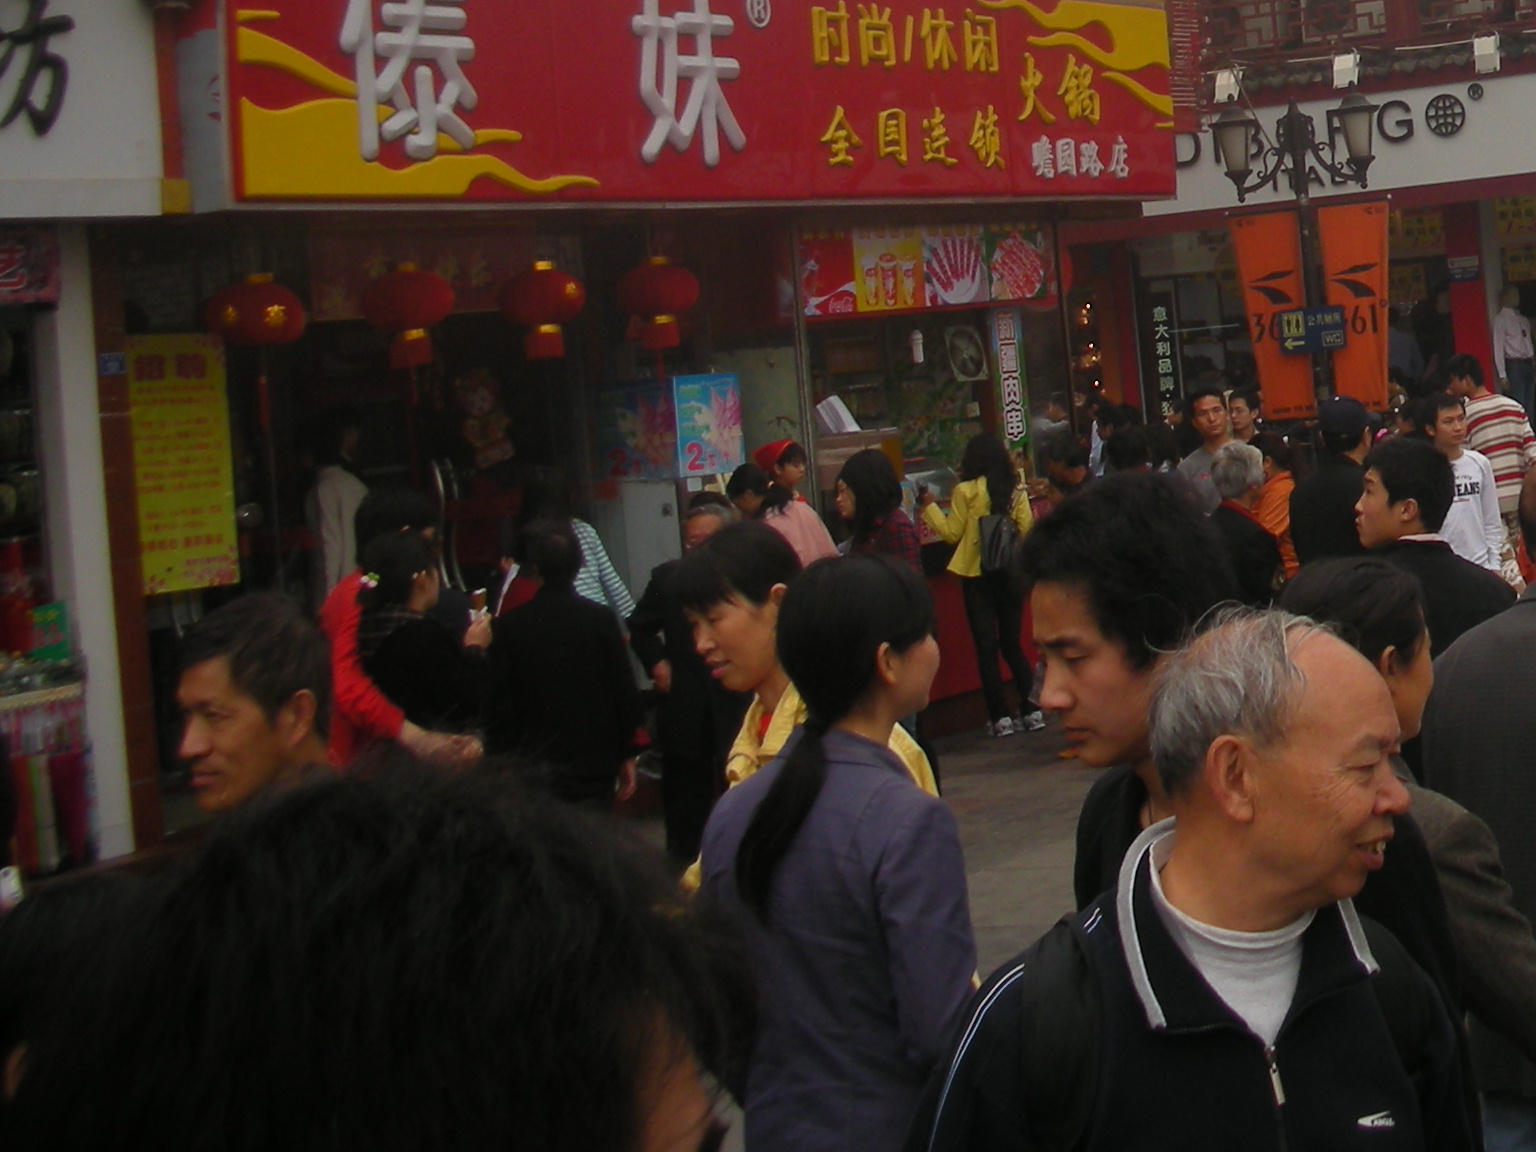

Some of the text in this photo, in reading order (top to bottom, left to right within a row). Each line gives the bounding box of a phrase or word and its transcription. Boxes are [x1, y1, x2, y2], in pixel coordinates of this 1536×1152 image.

[811, 0, 1000, 74] 时尚/休闲
[1018, 51, 1101, 126] 火锅
[820, 104, 1006, 170] 全国连锁
[1324, 333, 1342, 344] WC
[996, 310, 1027, 440] 新疆肉串
[1454, 481, 1481, 497] EANS
